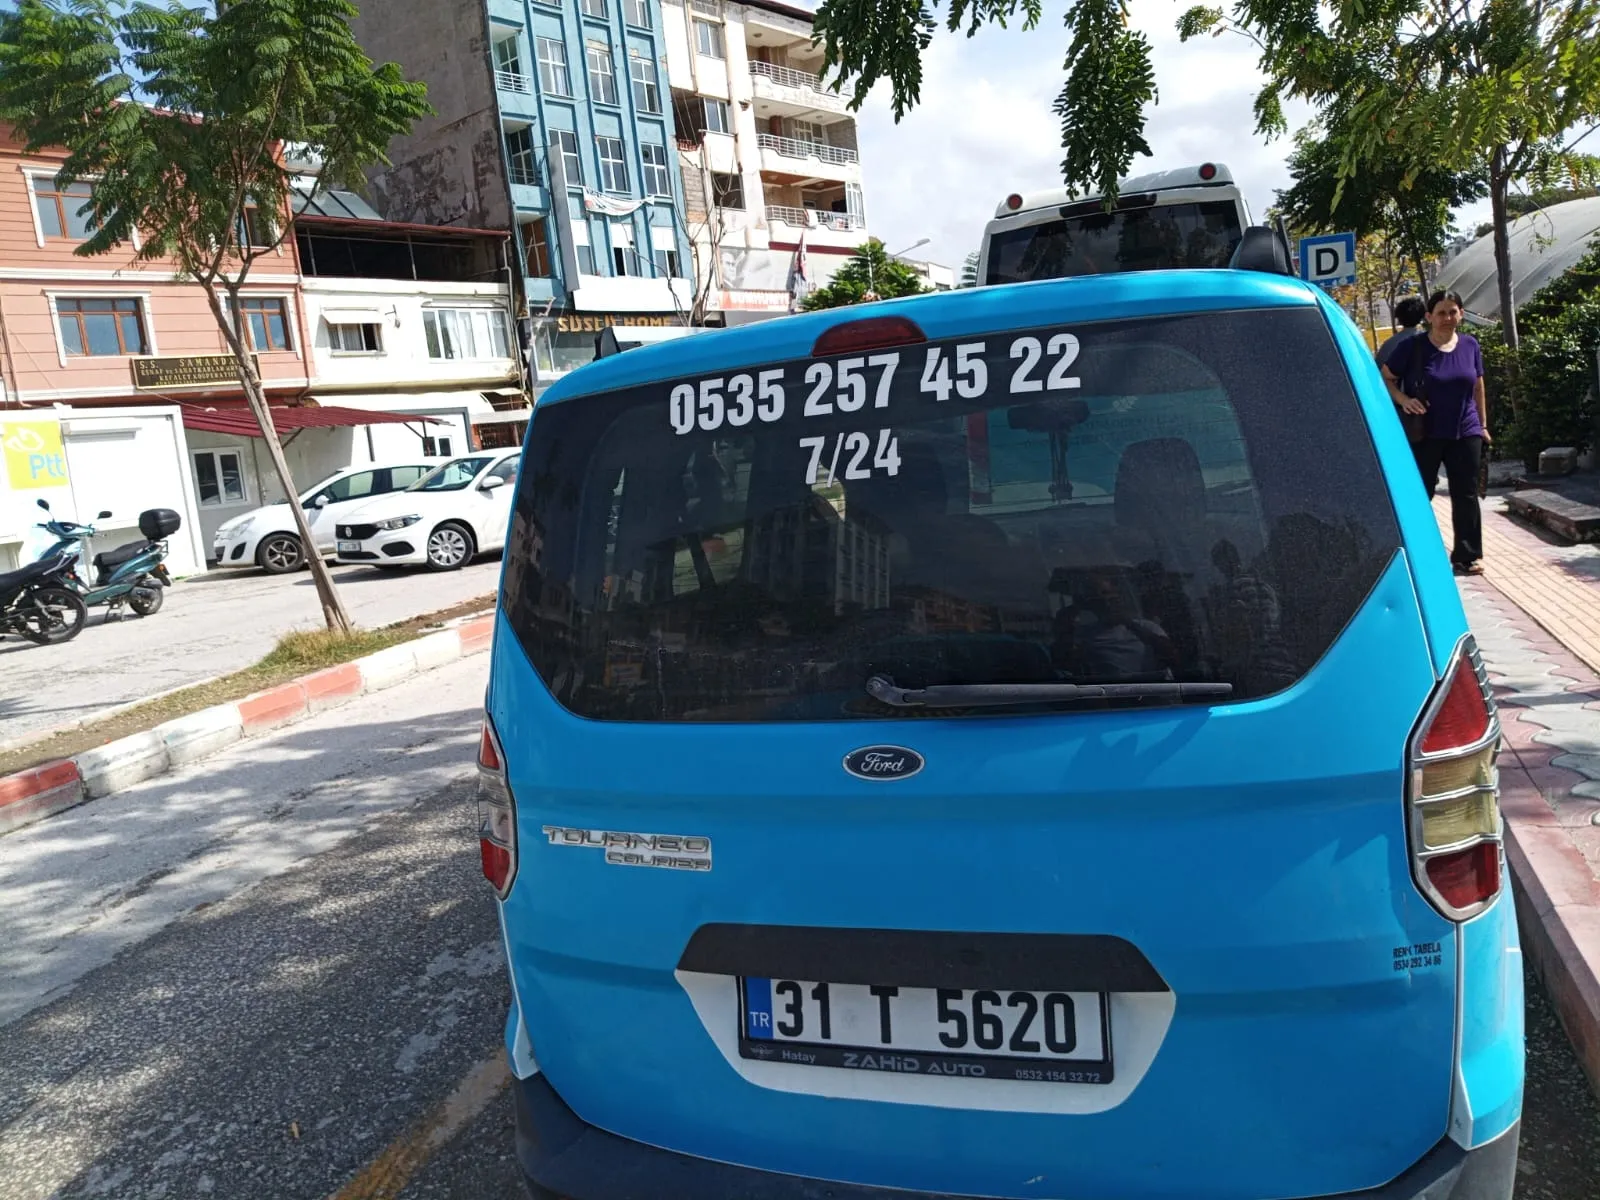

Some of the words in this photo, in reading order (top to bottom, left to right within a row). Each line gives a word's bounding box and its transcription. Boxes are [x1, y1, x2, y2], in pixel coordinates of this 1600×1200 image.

[1315, 247, 1340, 276] D
[669, 368, 786, 436] 0535
[803, 352, 901, 418] 257
[920, 341, 989, 401] 45
[1009, 333, 1081, 394] 22
[29, 453, 65, 479] Ptt
[799, 428, 902, 489] 7/24
[861, 752, 905, 772] Ford
[542, 825, 710, 853] TOURNEO
[750, 1011, 770, 1027] TR
[776, 981, 831, 1040] 31
[870, 984, 899, 1044] T
[936, 989, 1077, 1054] 5620
[782, 1050, 816, 1064] Hatay
[928, 1062, 986, 1077] AUTO
